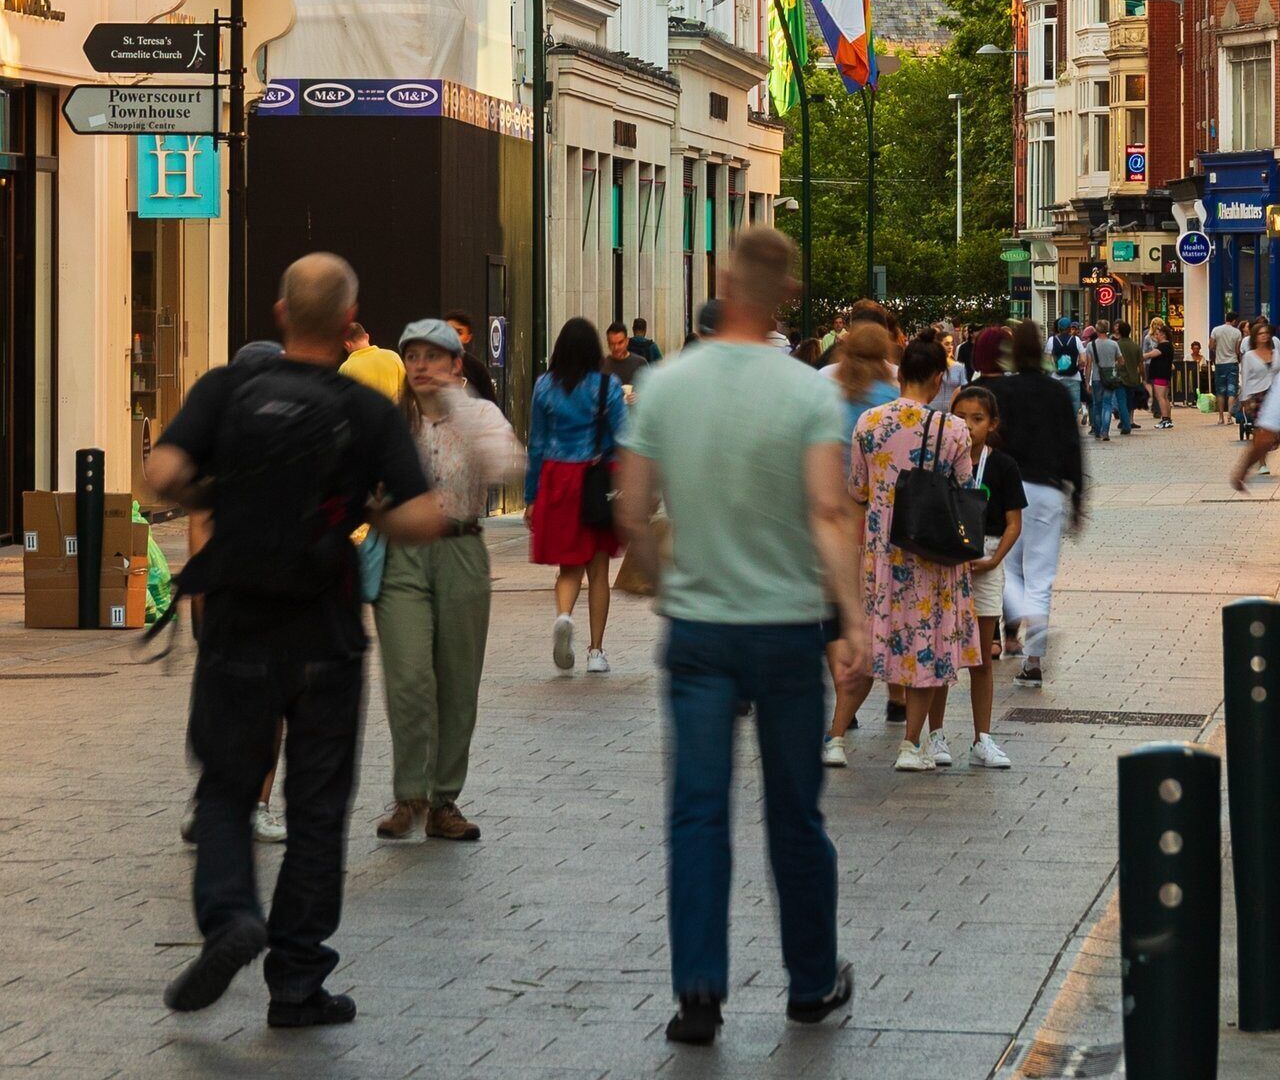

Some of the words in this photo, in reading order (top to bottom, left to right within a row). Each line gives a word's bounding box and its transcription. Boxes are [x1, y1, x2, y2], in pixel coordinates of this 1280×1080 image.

[123, 36, 134, 45] St.
[136, 36, 172, 45] Teresa's
[110, 49, 150, 59] Carmelite
[152, 50, 182, 59] Church
[108, 89, 201, 103] Powerscourt
[314, 90, 345, 101] M&P
[397, 90, 428, 101] M&P
[108, 104, 191, 119] Townhouse
[107, 121, 146, 130] Shopping
[148, 121, 176, 130] Centre
